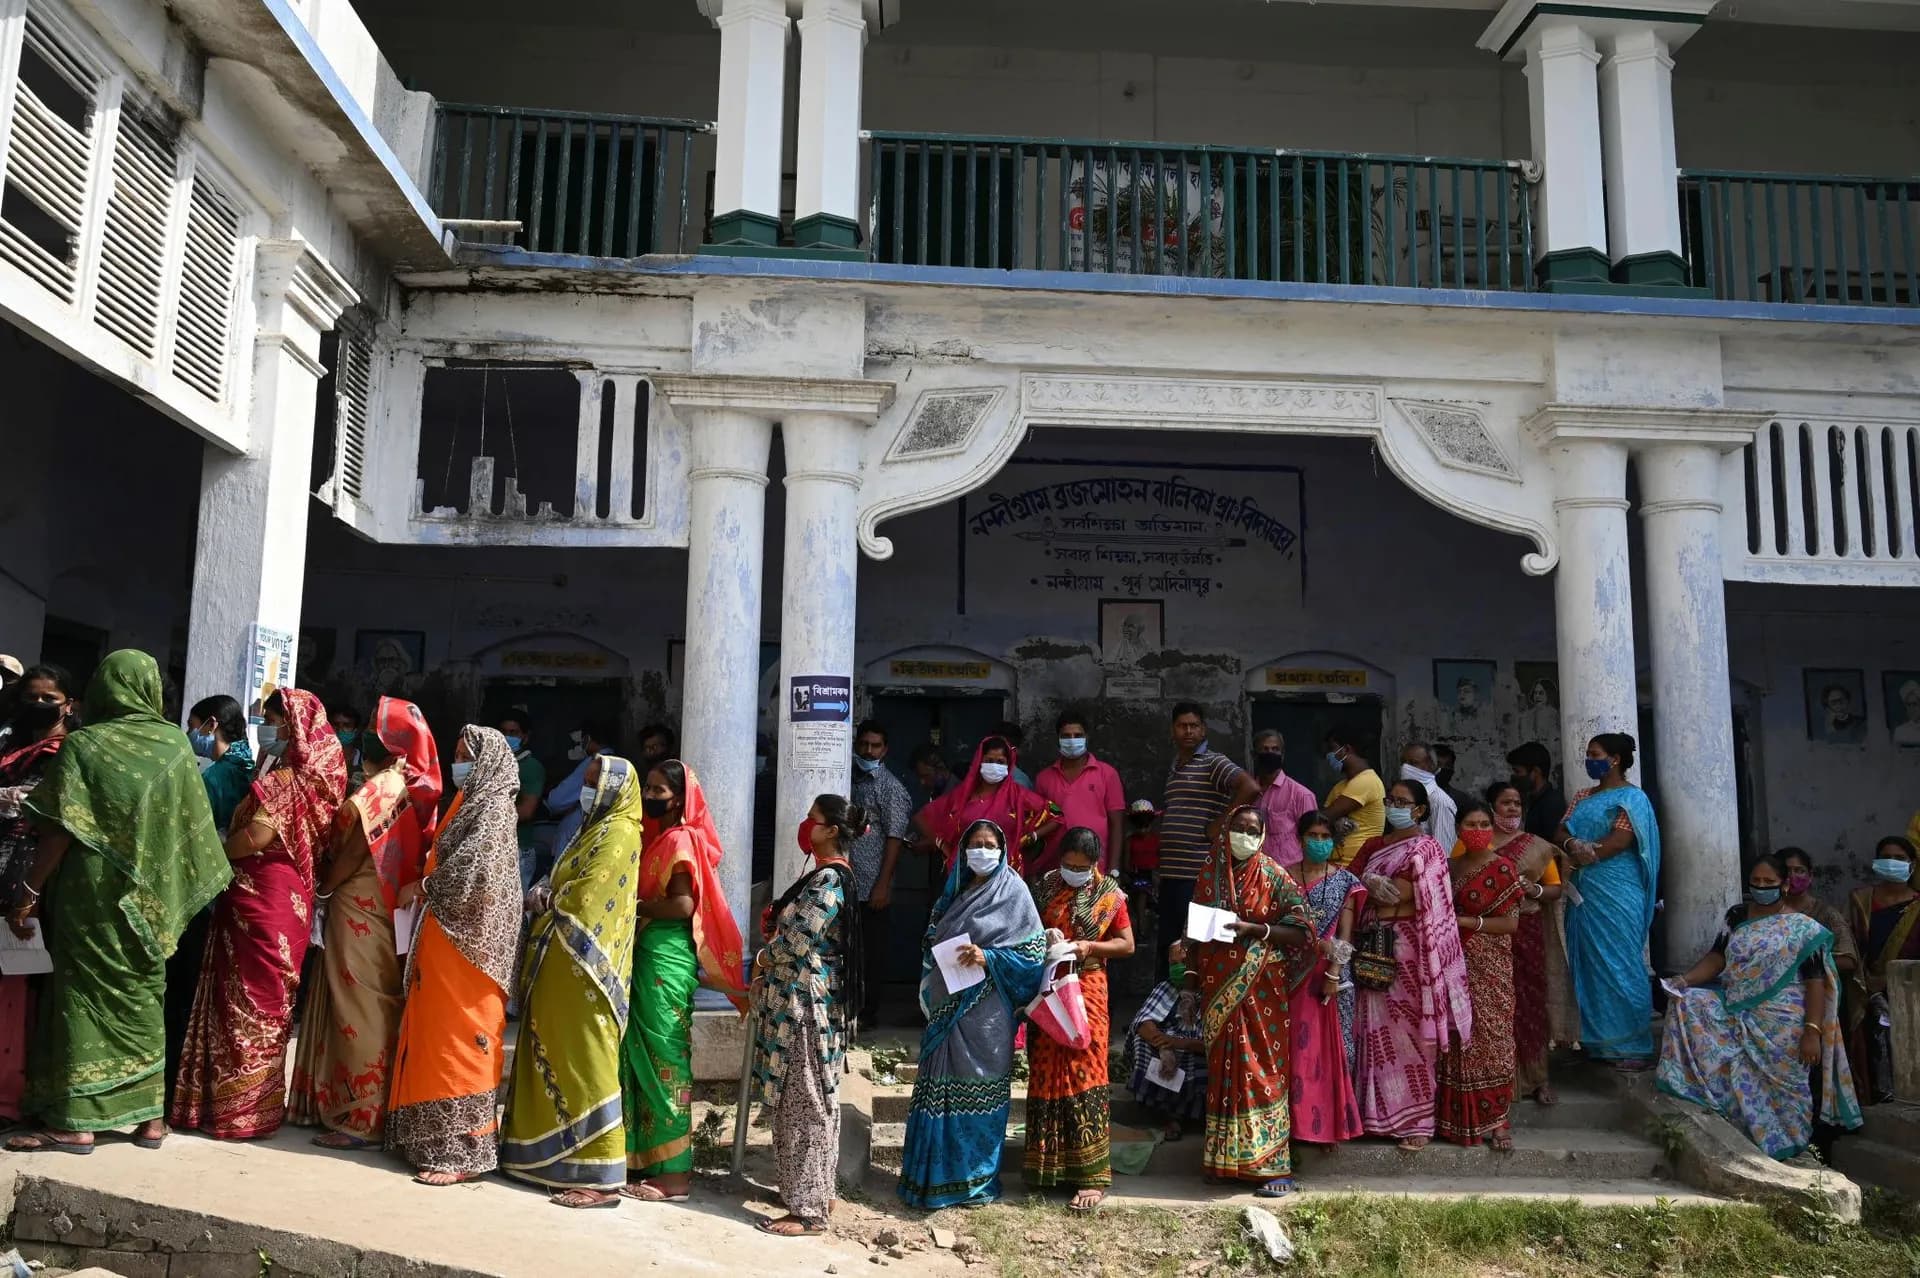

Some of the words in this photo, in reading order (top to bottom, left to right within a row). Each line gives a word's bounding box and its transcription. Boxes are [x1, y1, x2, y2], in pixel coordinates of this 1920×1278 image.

[968, 486, 1052, 537] নন্দীগ্রাম
[1053, 476, 1151, 509] ব্রজমোহন
[1153, 475, 1216, 516] বালিকা
[1054, 548, 1093, 563] সবার
[1142, 551, 1178, 566] সবার
[1121, 572, 1144, 596] পূর্ব
[271, 637, 288, 652] VOTE
